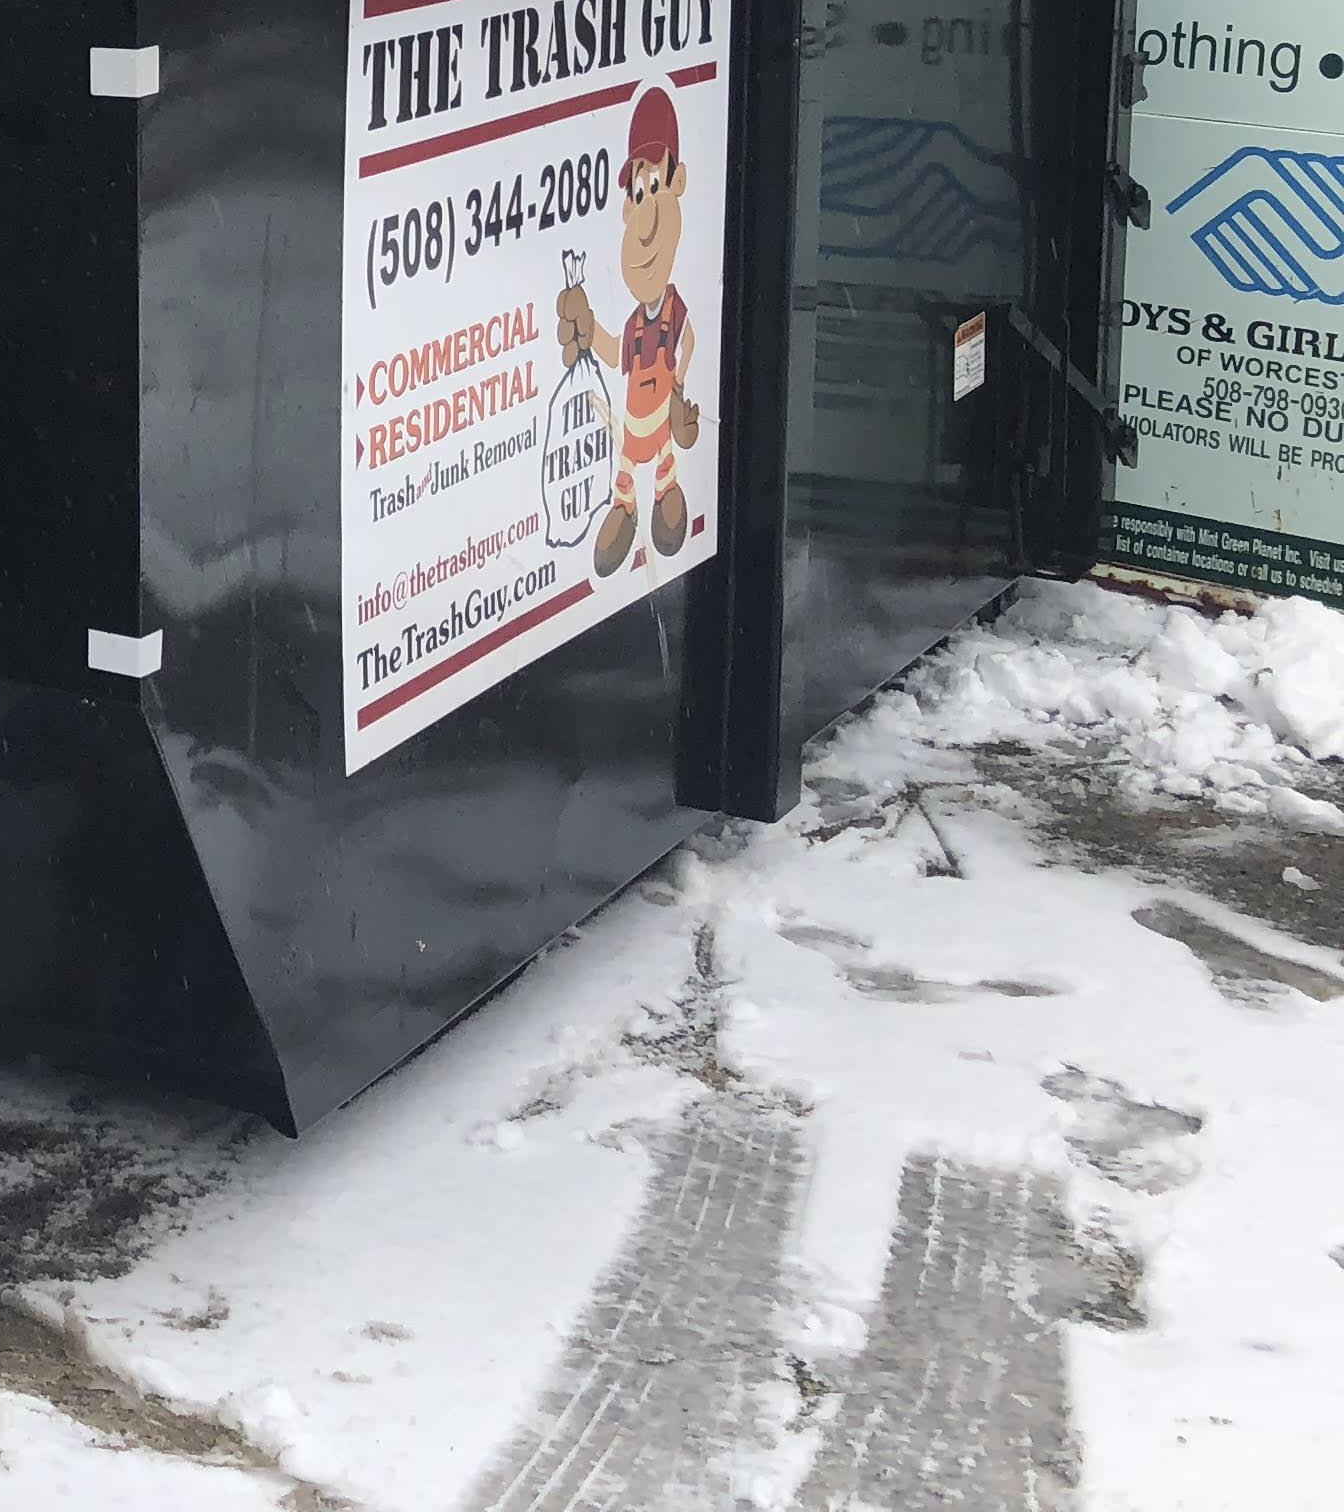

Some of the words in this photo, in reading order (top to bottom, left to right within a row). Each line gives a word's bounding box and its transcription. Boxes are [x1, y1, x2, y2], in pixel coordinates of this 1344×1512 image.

[363, 23, 463, 131] THE
[1138, 21, 1302, 93] othing
[366, 196, 456, 309] (508)
[464, 147, 609, 257] 344-2080
[368, 302, 539, 406] COMMERCIAL
[1120, 299, 1191, 336] OYS
[1202, 313, 1236, 344] &
[1247, 320, 1344, 363] GIRL
[1176, 345, 1212, 367] OF
[1220, 352, 1344, 391] WORCES
[1202, 377, 1344, 421] 508-798-093
[368, 360, 538, 470] RESIDENTIAL
[562, 389, 596, 436] THE
[1123, 383, 1233, 423] PLEASE
[1246, 406, 1289, 433] NO
[1303, 416, 1344, 443] DU
[1123, 413, 1221, 449] VIOLATORS
[1229, 433, 1270, 459] WILL
[1278, 443, 1303, 465] BE
[370, 474, 416, 522] Trash
[416, 463, 433, 500] and
[430, 449, 470, 495] Junk
[474, 416, 537, 474] Removal
[546, 427, 609, 484] TRASH
[561, 475, 594, 521] GUY
[357, 510, 540, 626] info@thetrashguy.com
[1116, 534, 1131, 552] list
[1133, 539, 1144, 555] of
[1146, 542, 1190, 565] container
[1192, 549, 1235, 575] locations
[1237, 563, 1249, 577] or
[1250, 563, 1269, 581] call
[1270, 570, 1283, 584] us
[1285, 569, 1296, 587] to
[1299, 574, 1343, 596] schedule
[1121, 516, 1173, 541] responsibly
[1177, 525, 1196, 543] with
[1198, 528, 1218, 548] Mint
[1221, 533, 1250, 553] Green
[1252, 539, 1283, 562] Planet
[1309, 549, 1331, 571] Visit
[356, 559, 557, 691] TheTrashGuy.com
